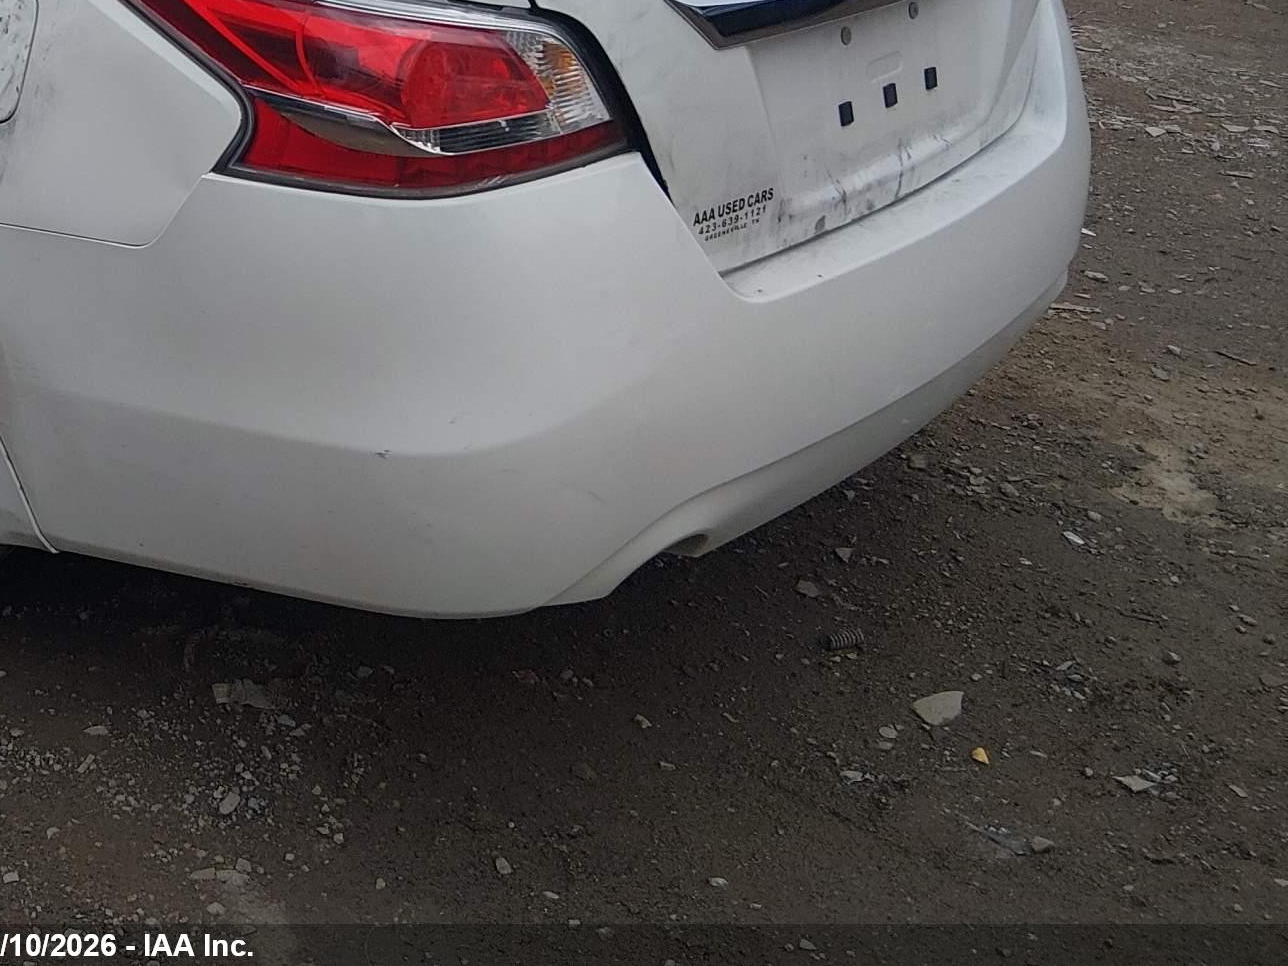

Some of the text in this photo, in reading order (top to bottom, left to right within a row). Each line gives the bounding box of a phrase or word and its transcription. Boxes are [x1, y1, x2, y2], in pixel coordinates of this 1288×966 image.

[693, 187, 774, 227] AAA USED CARS
[698, 204, 767, 235] 423-639-1121
